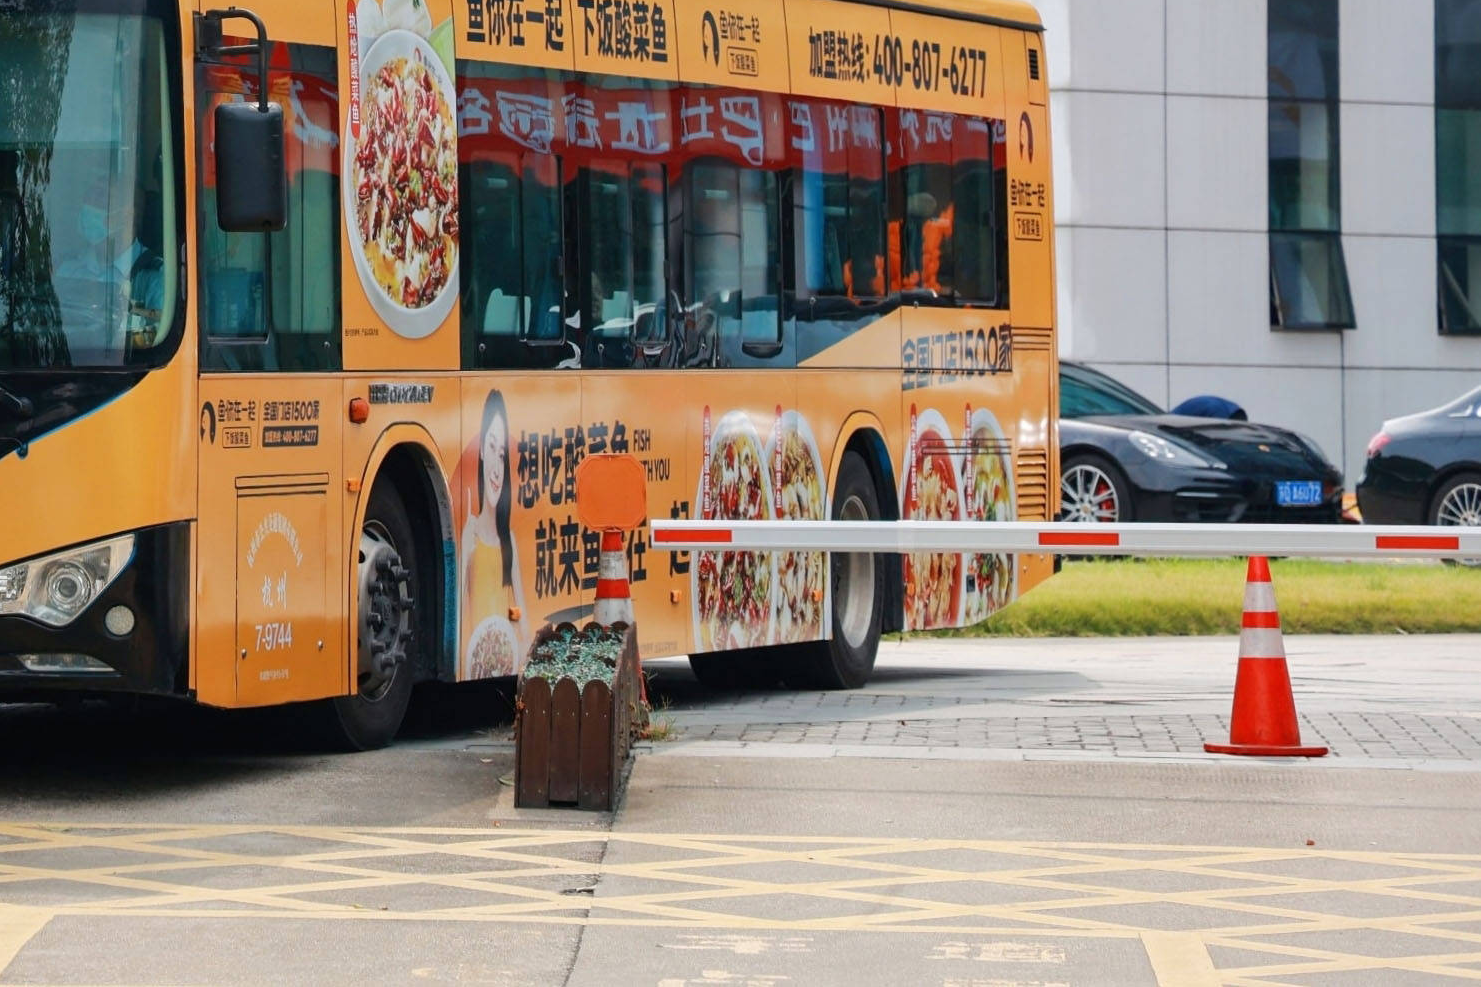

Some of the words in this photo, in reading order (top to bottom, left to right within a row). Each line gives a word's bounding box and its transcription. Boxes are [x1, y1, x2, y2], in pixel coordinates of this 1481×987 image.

[633, 428, 651, 452] FISH
[654, 457, 670, 482] YOU
[255, 622, 292, 652] 7-9744
